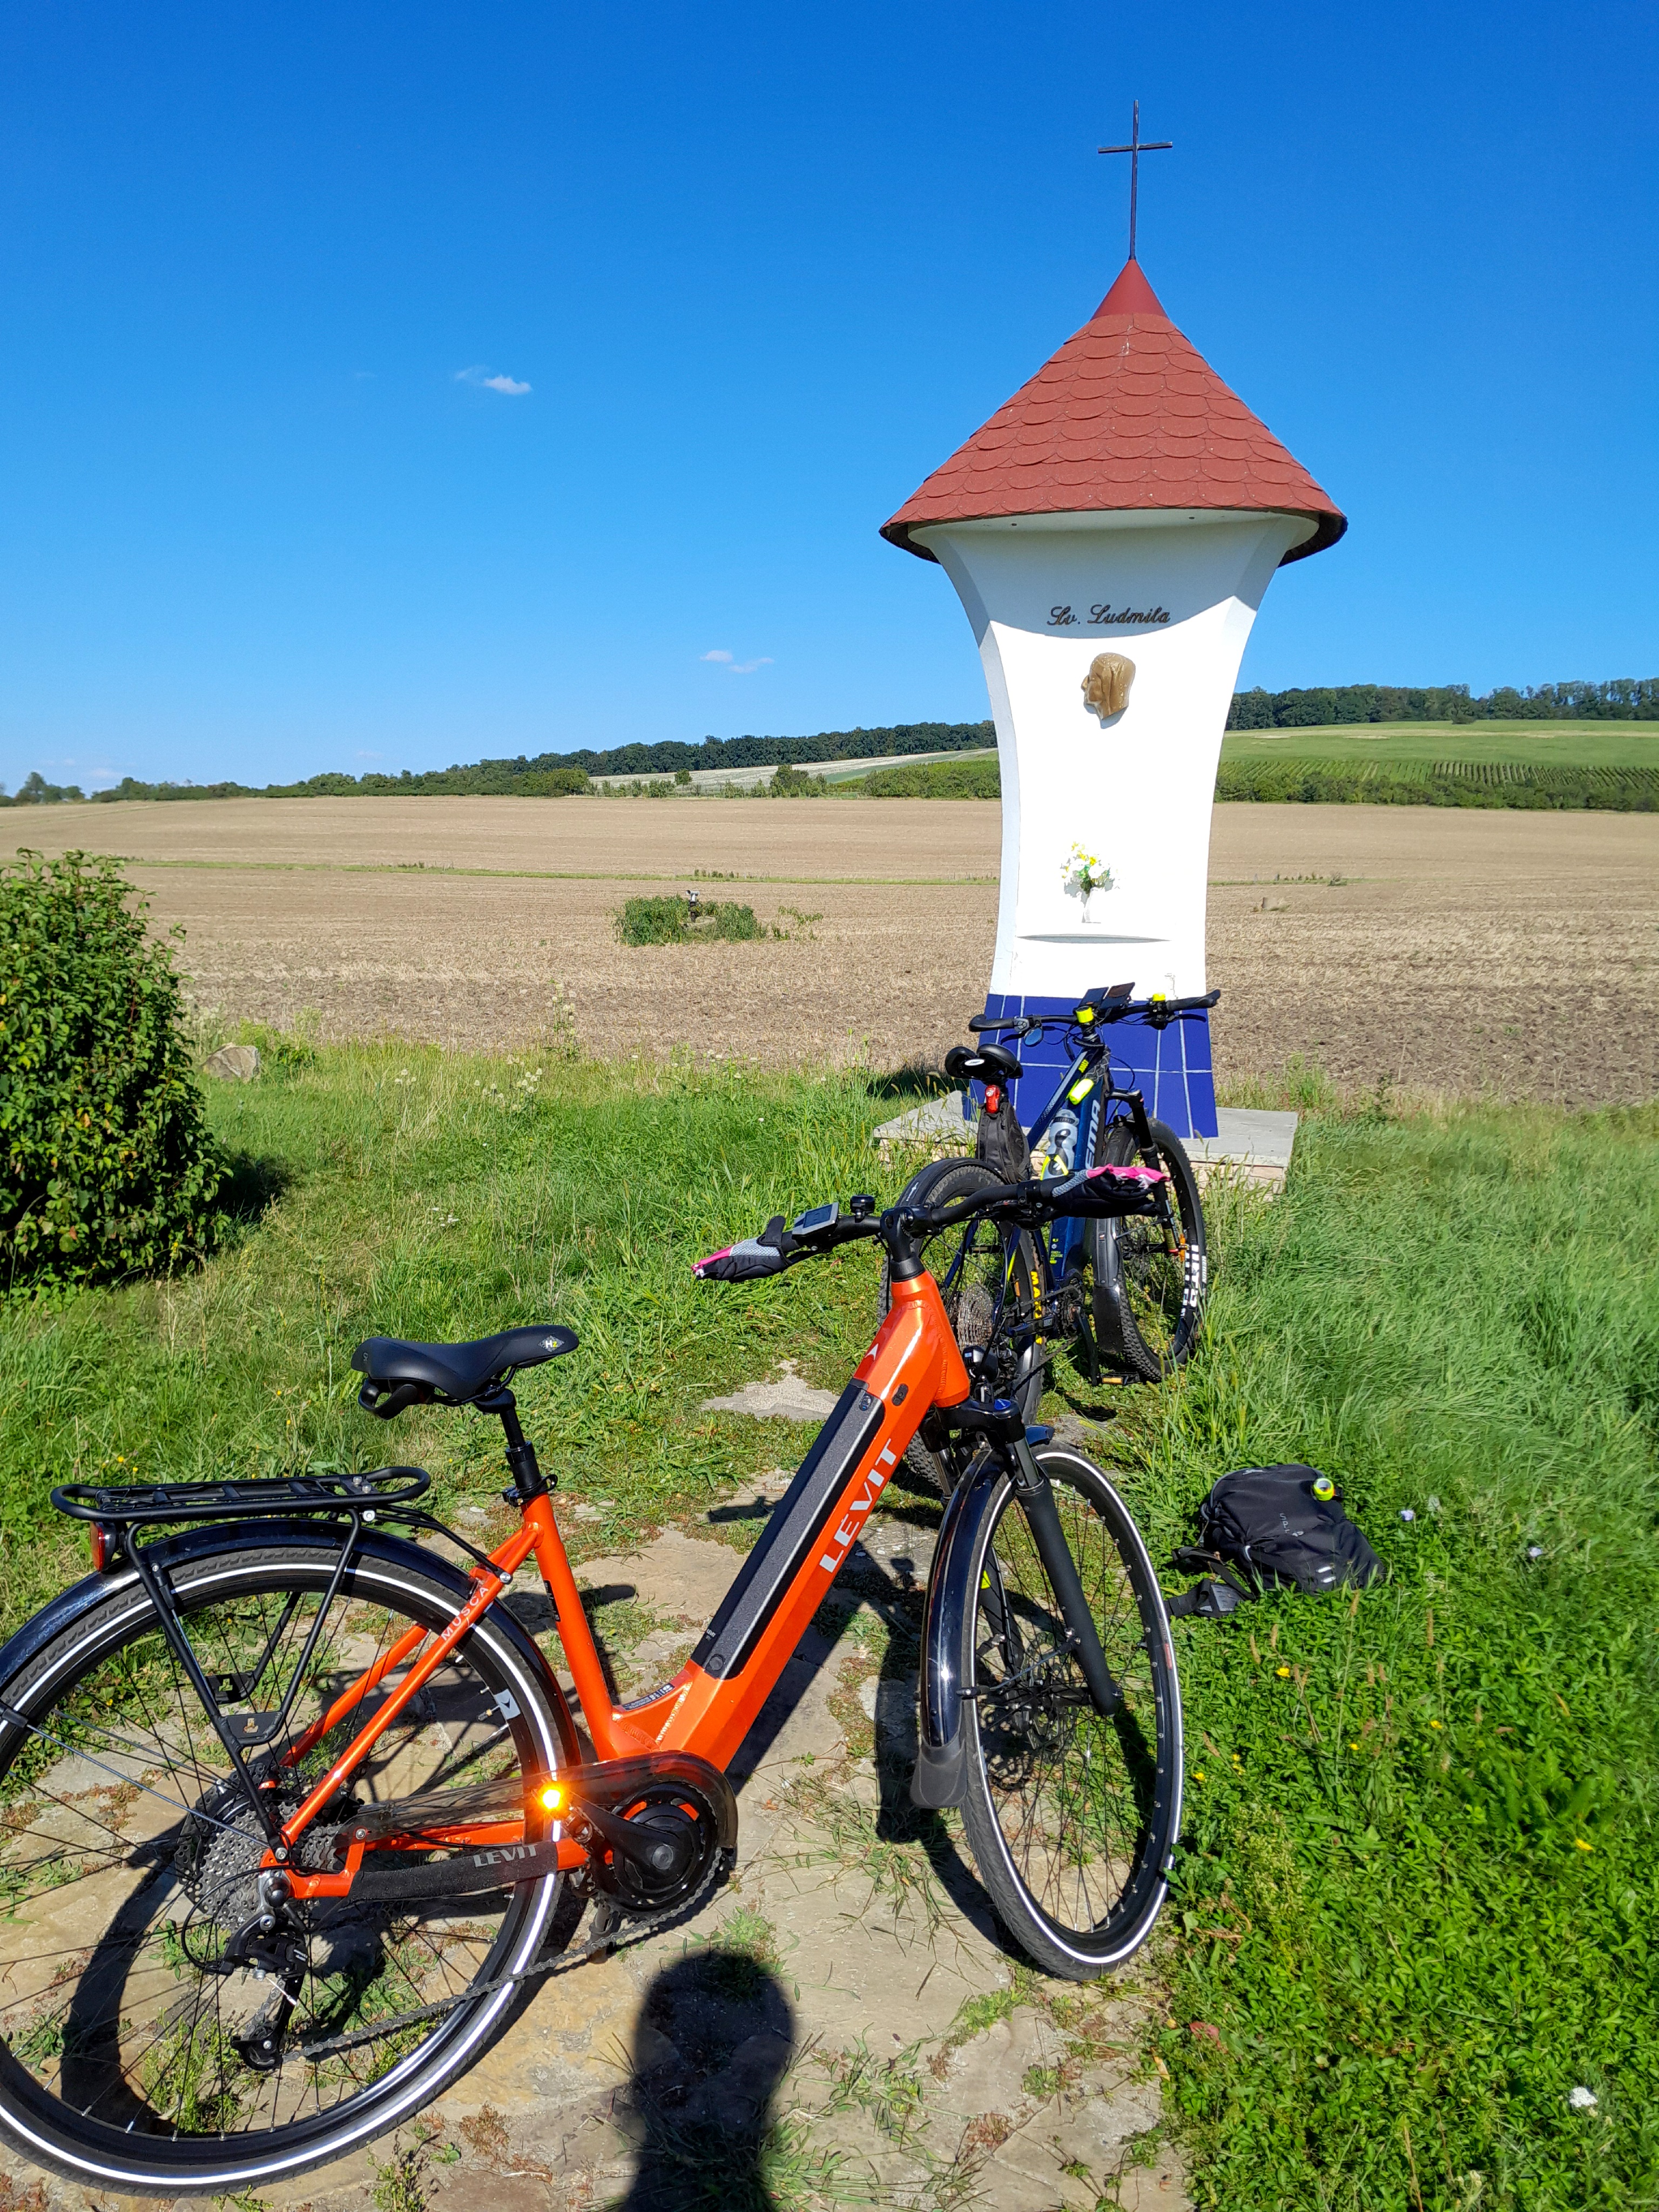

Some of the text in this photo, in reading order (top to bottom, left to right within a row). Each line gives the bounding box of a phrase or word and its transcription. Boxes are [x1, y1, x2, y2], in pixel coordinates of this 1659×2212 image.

[1047, 604, 1171, 625] Sv. Ludmila
[1085, 1100, 1101, 1170] EMA
[819, 1438, 897, 1573] LEVIT
[441, 1587, 489, 1641] MUSCA
[473, 1843, 538, 1867] LEVIT
